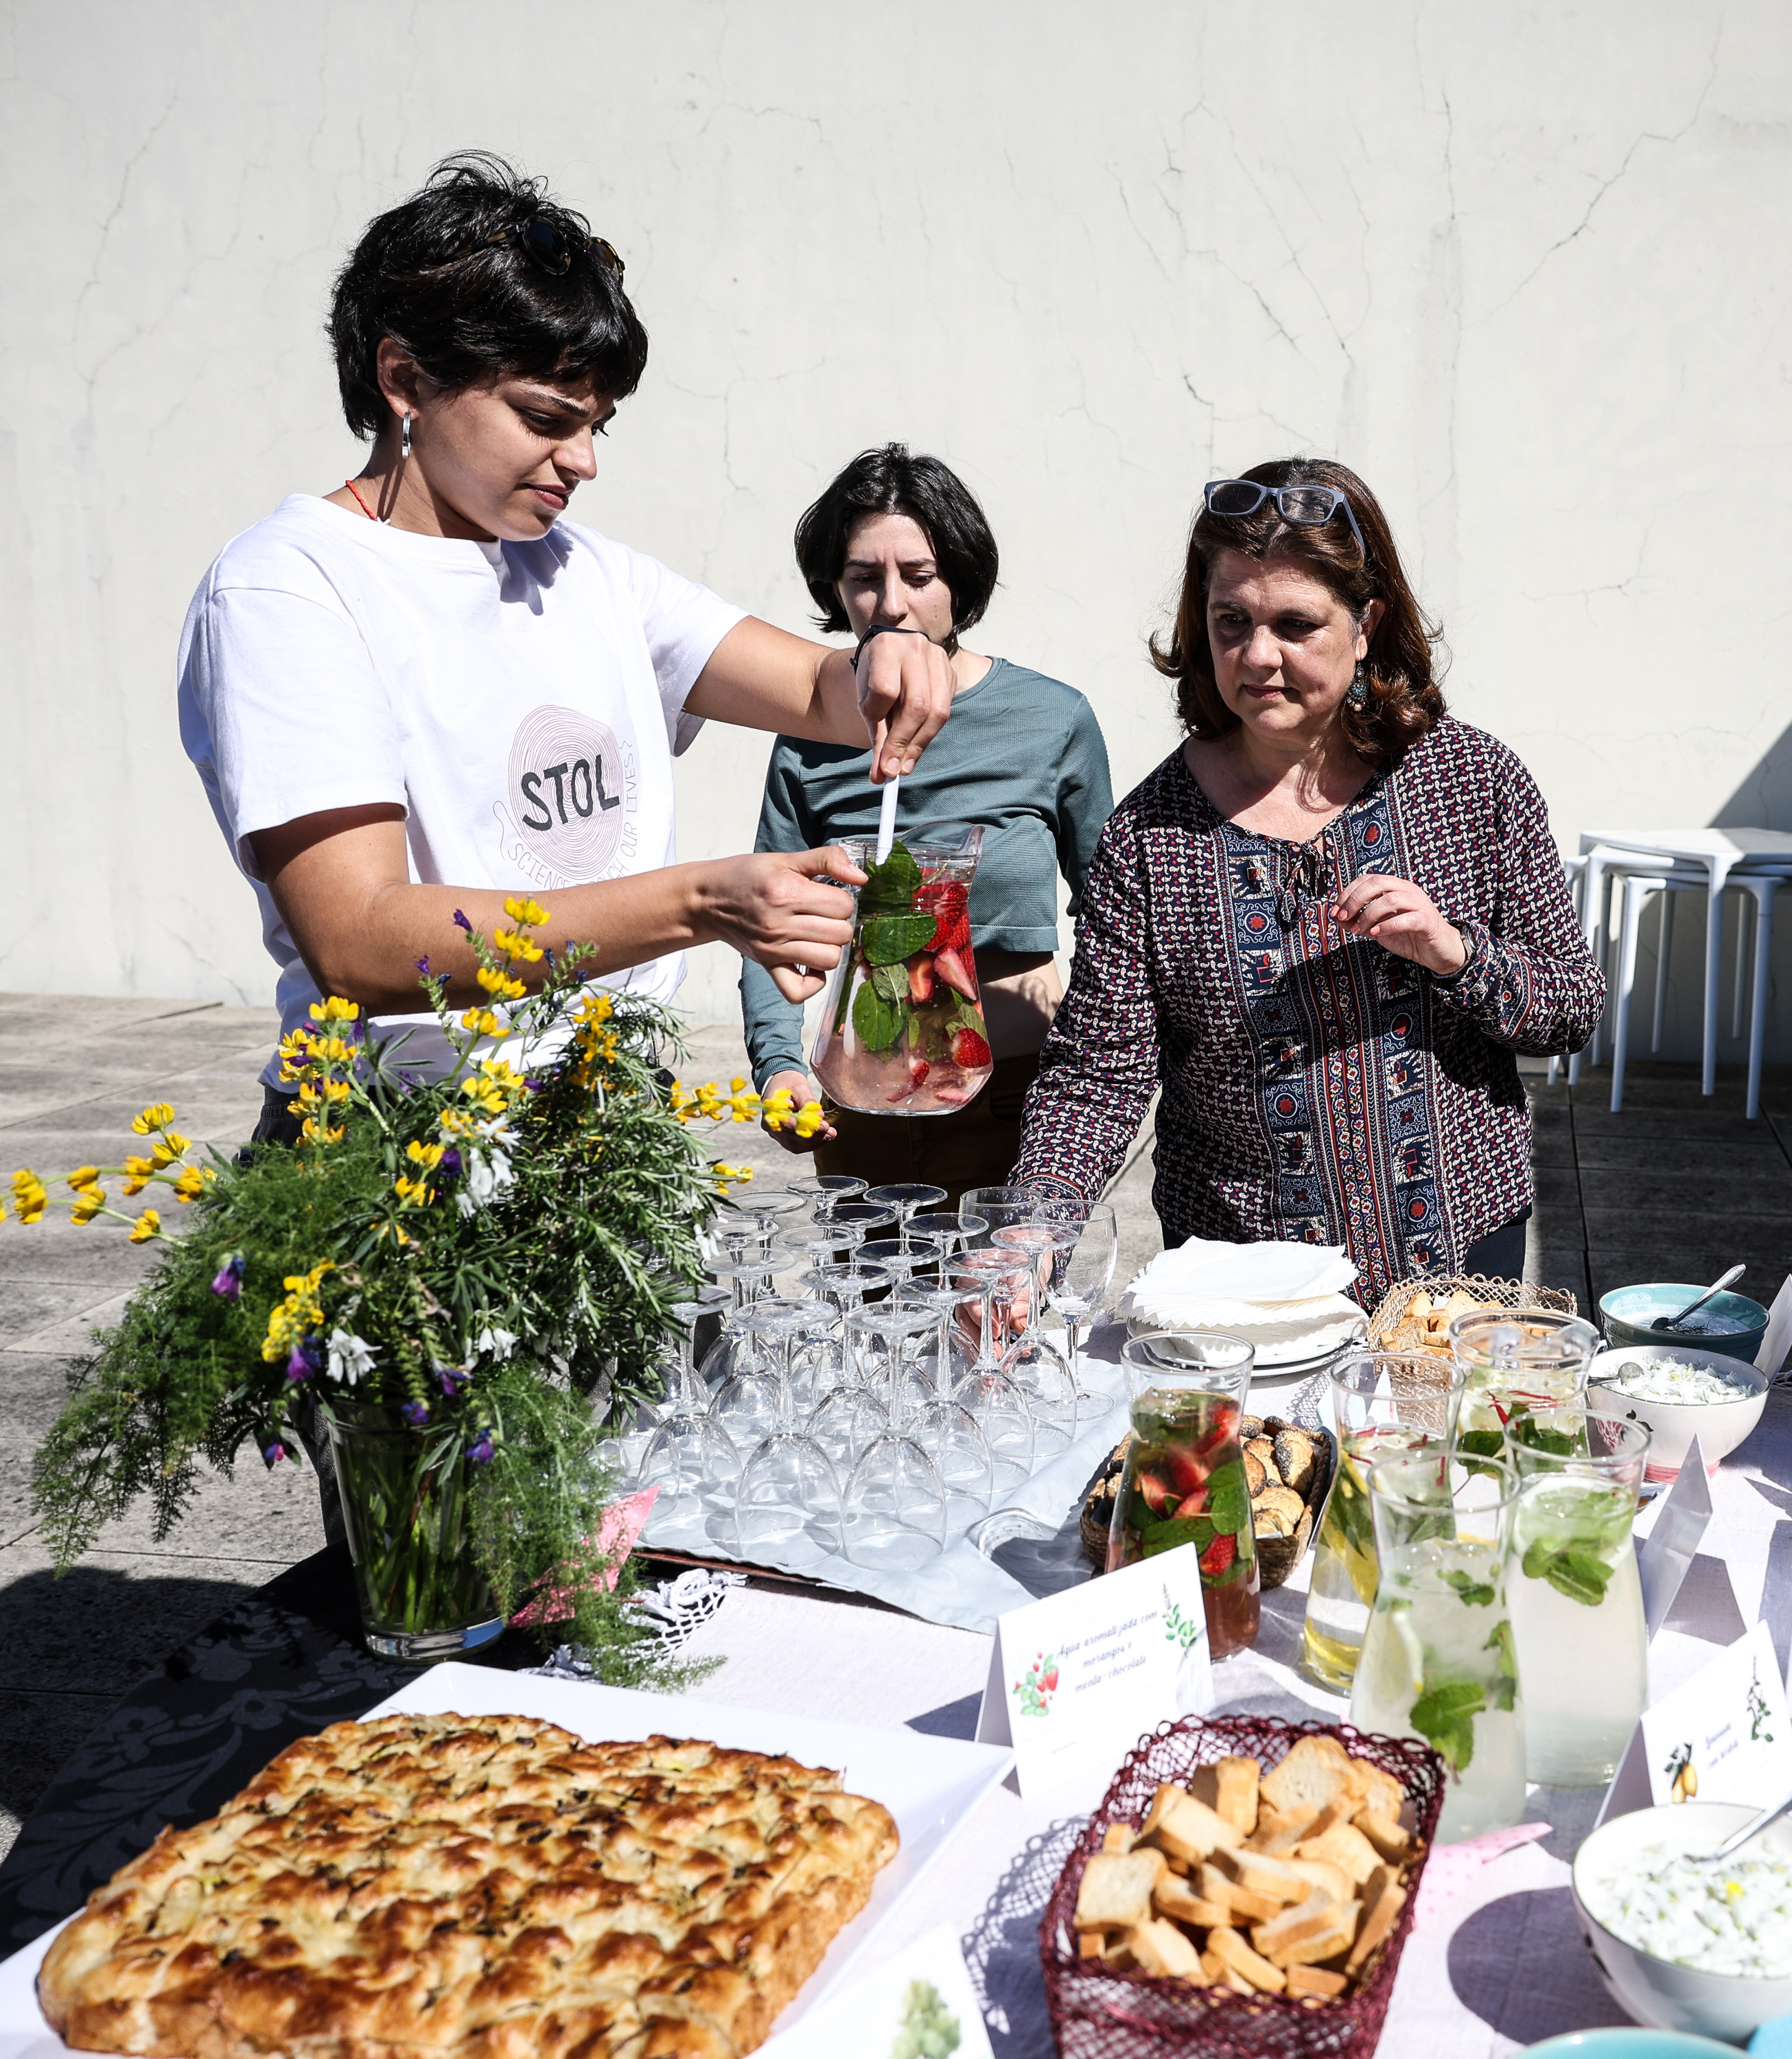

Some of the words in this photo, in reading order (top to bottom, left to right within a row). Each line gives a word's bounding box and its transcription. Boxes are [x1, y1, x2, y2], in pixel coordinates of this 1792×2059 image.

[522, 754, 620, 831] STOL
[624, 753, 638, 813] LIVES
[620, 822, 638, 857] OUR
